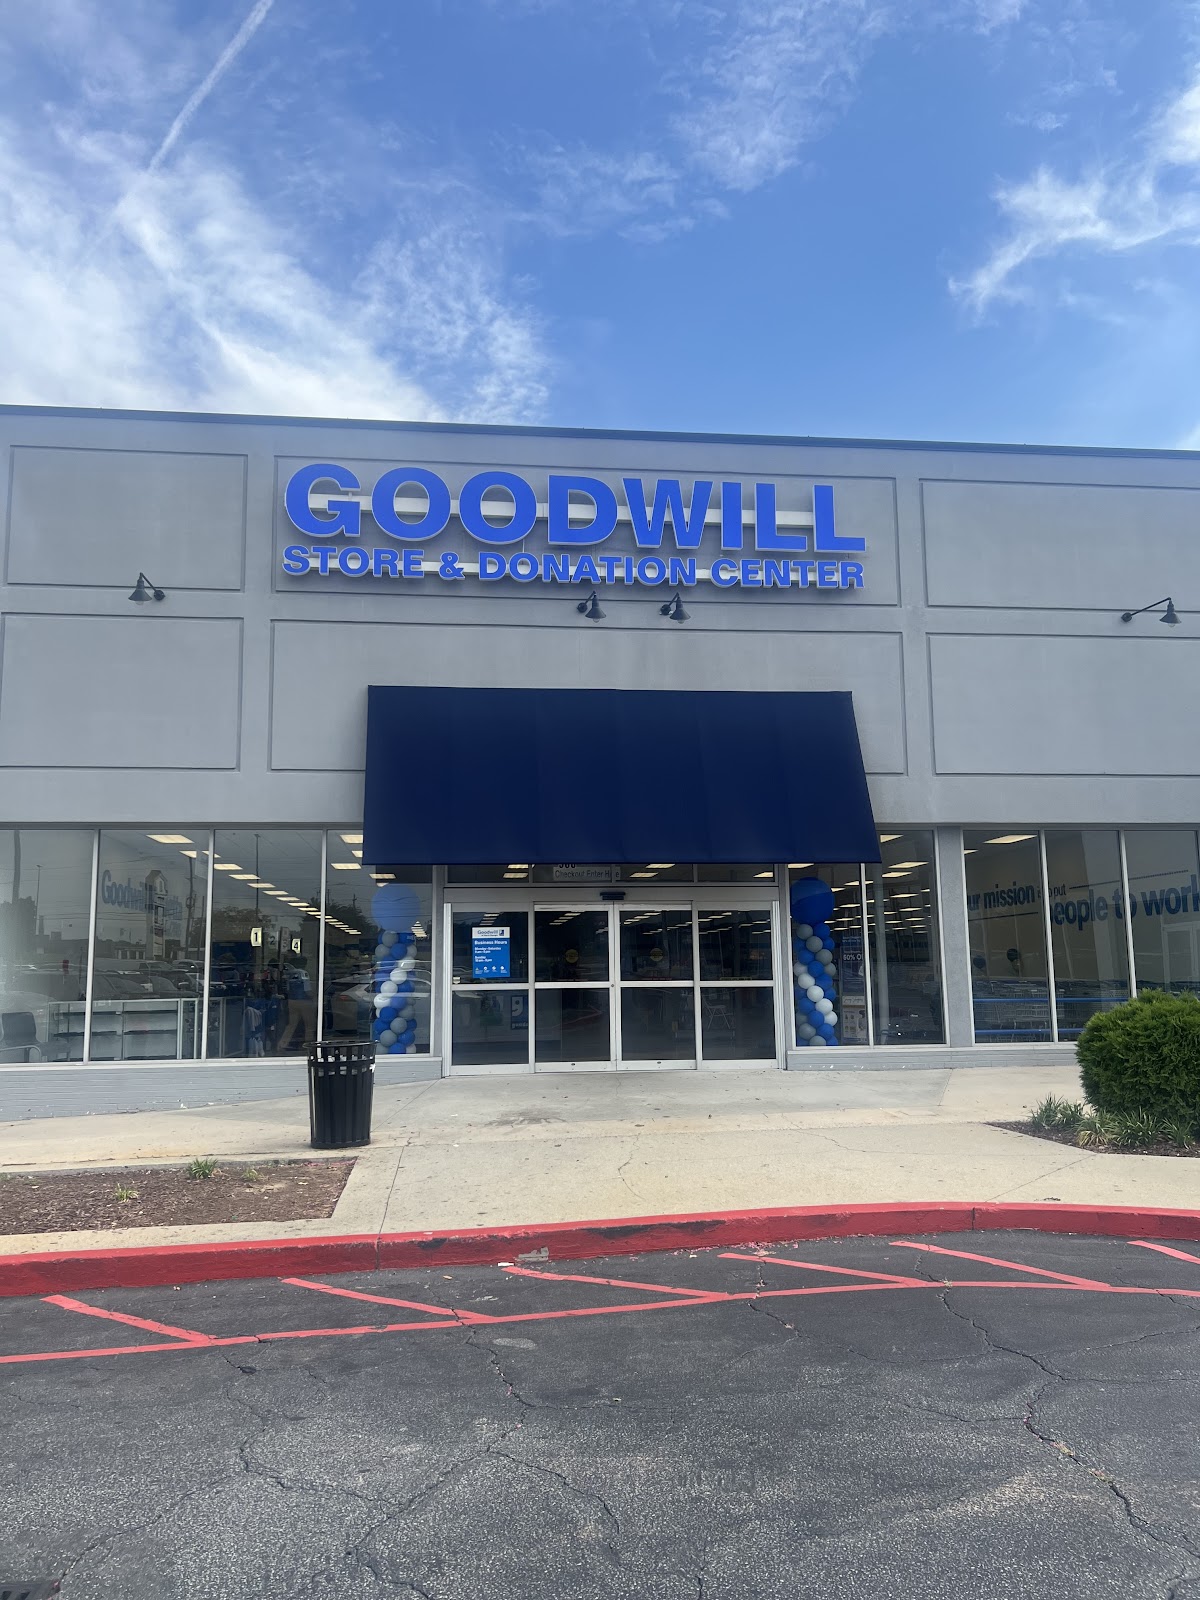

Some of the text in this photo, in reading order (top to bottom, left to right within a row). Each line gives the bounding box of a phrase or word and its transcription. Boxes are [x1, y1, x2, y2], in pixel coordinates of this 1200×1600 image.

[285, 463, 866, 553] GOODWILL
[282, 545, 865, 589] STORE & DONATION CENTER
[555, 869, 620, 878] Checkout Enter He
[968, 893, 981, 911] ur
[984, 881, 1036, 909] mission
[1053, 883, 1067, 899] put
[1050, 889, 1109, 931] eople
[270, 935, 275, 945] 2
